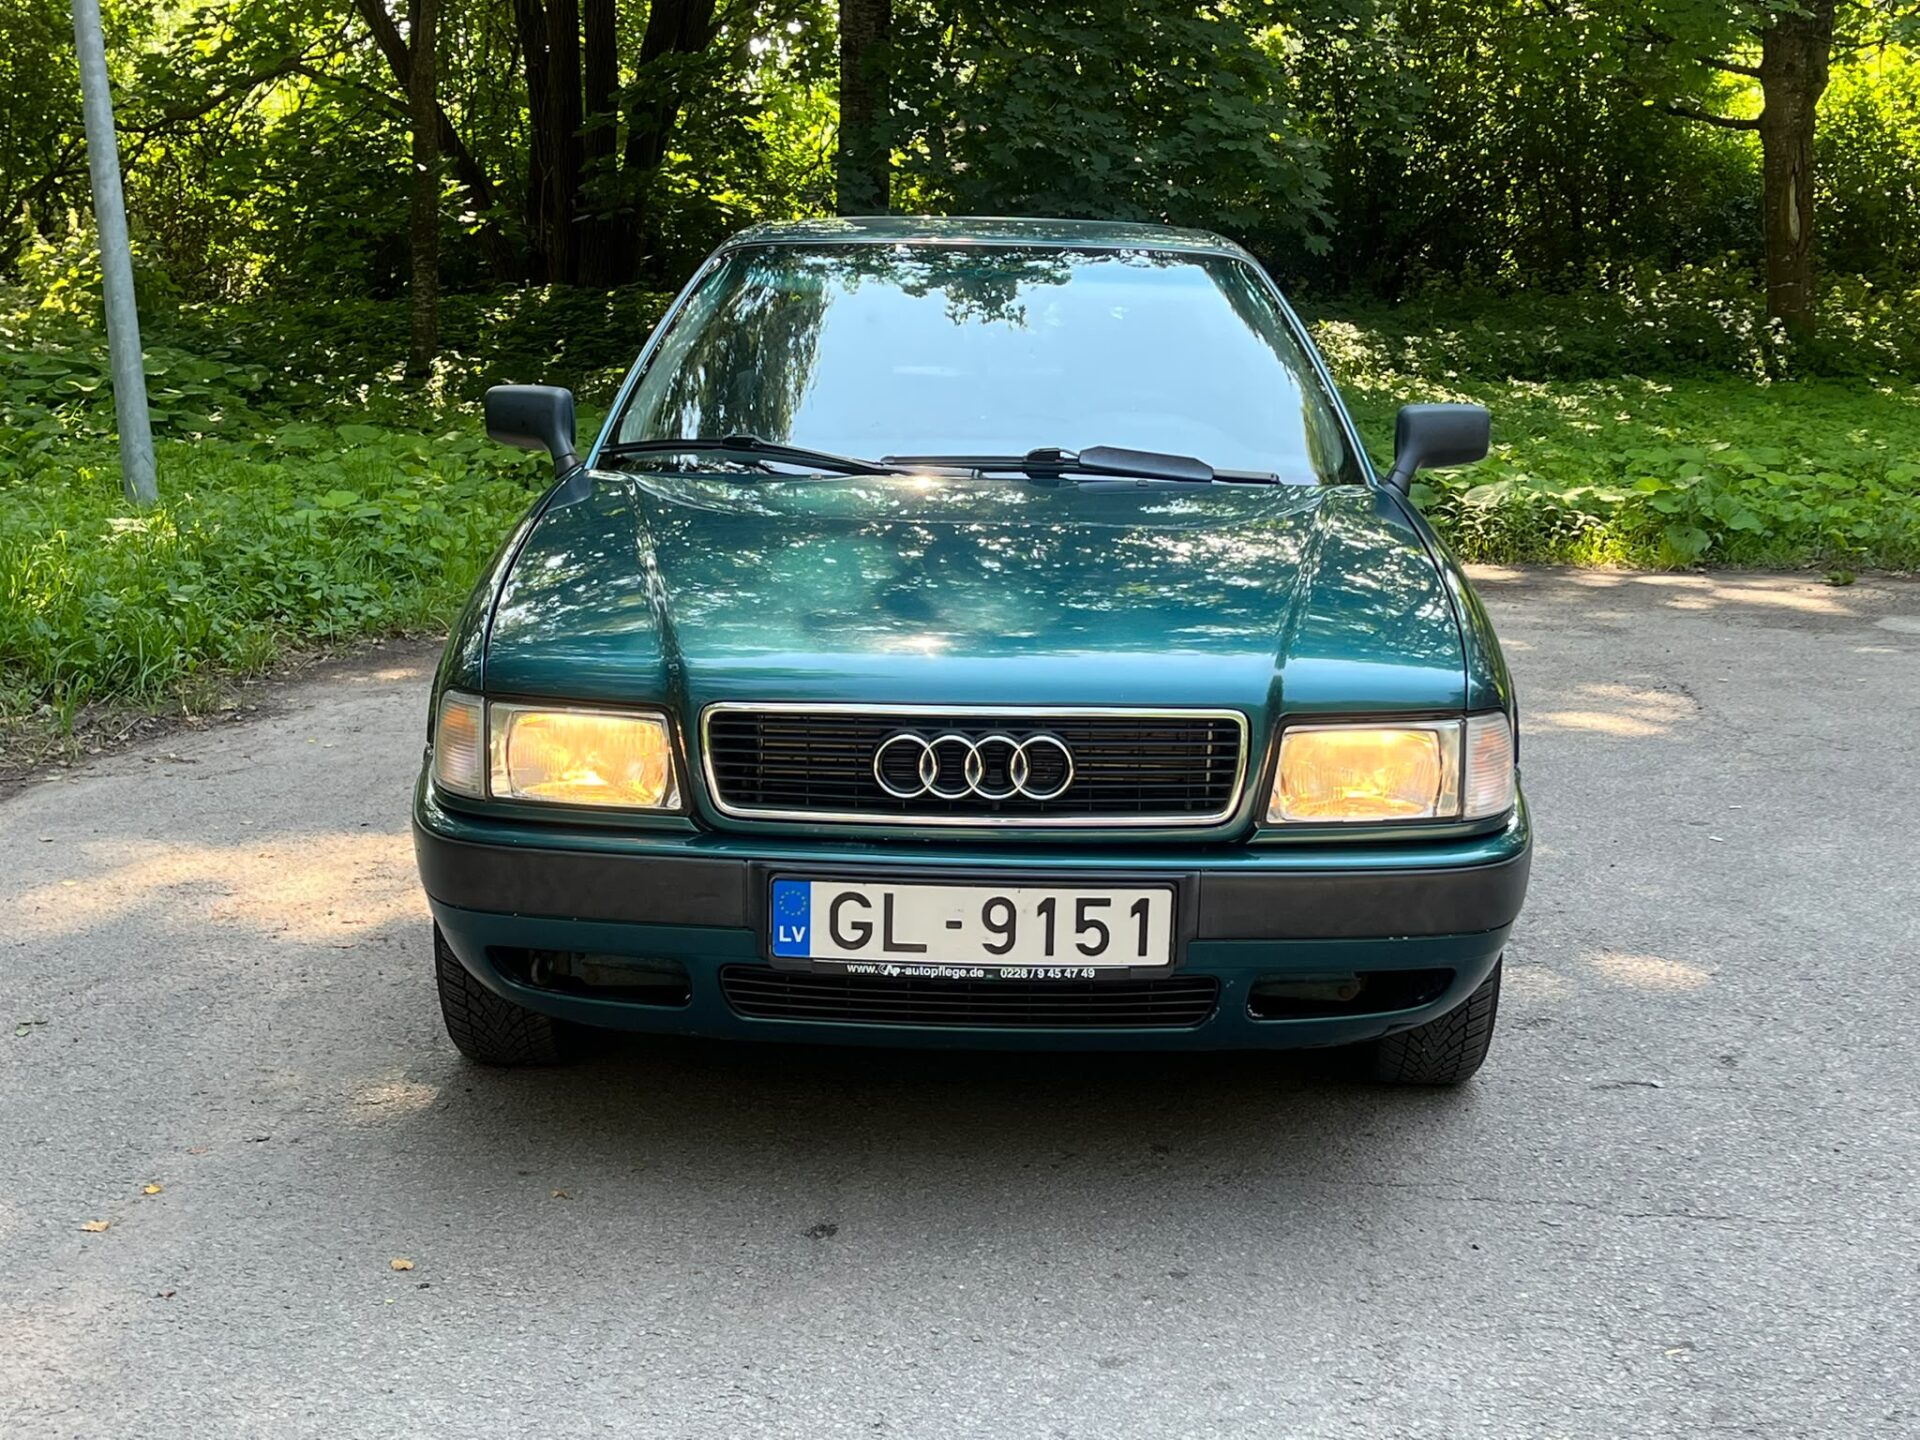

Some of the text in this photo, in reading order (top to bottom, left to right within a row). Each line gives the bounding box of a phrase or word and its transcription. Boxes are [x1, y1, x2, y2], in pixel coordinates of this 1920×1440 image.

[779, 925, 806, 943] LV
[1000, 968, 1028, 979] 0228
[1047, 968, 1061, 979] 45
[1064, 968, 1078, 979] 47
[1080, 968, 1095, 979] 49
